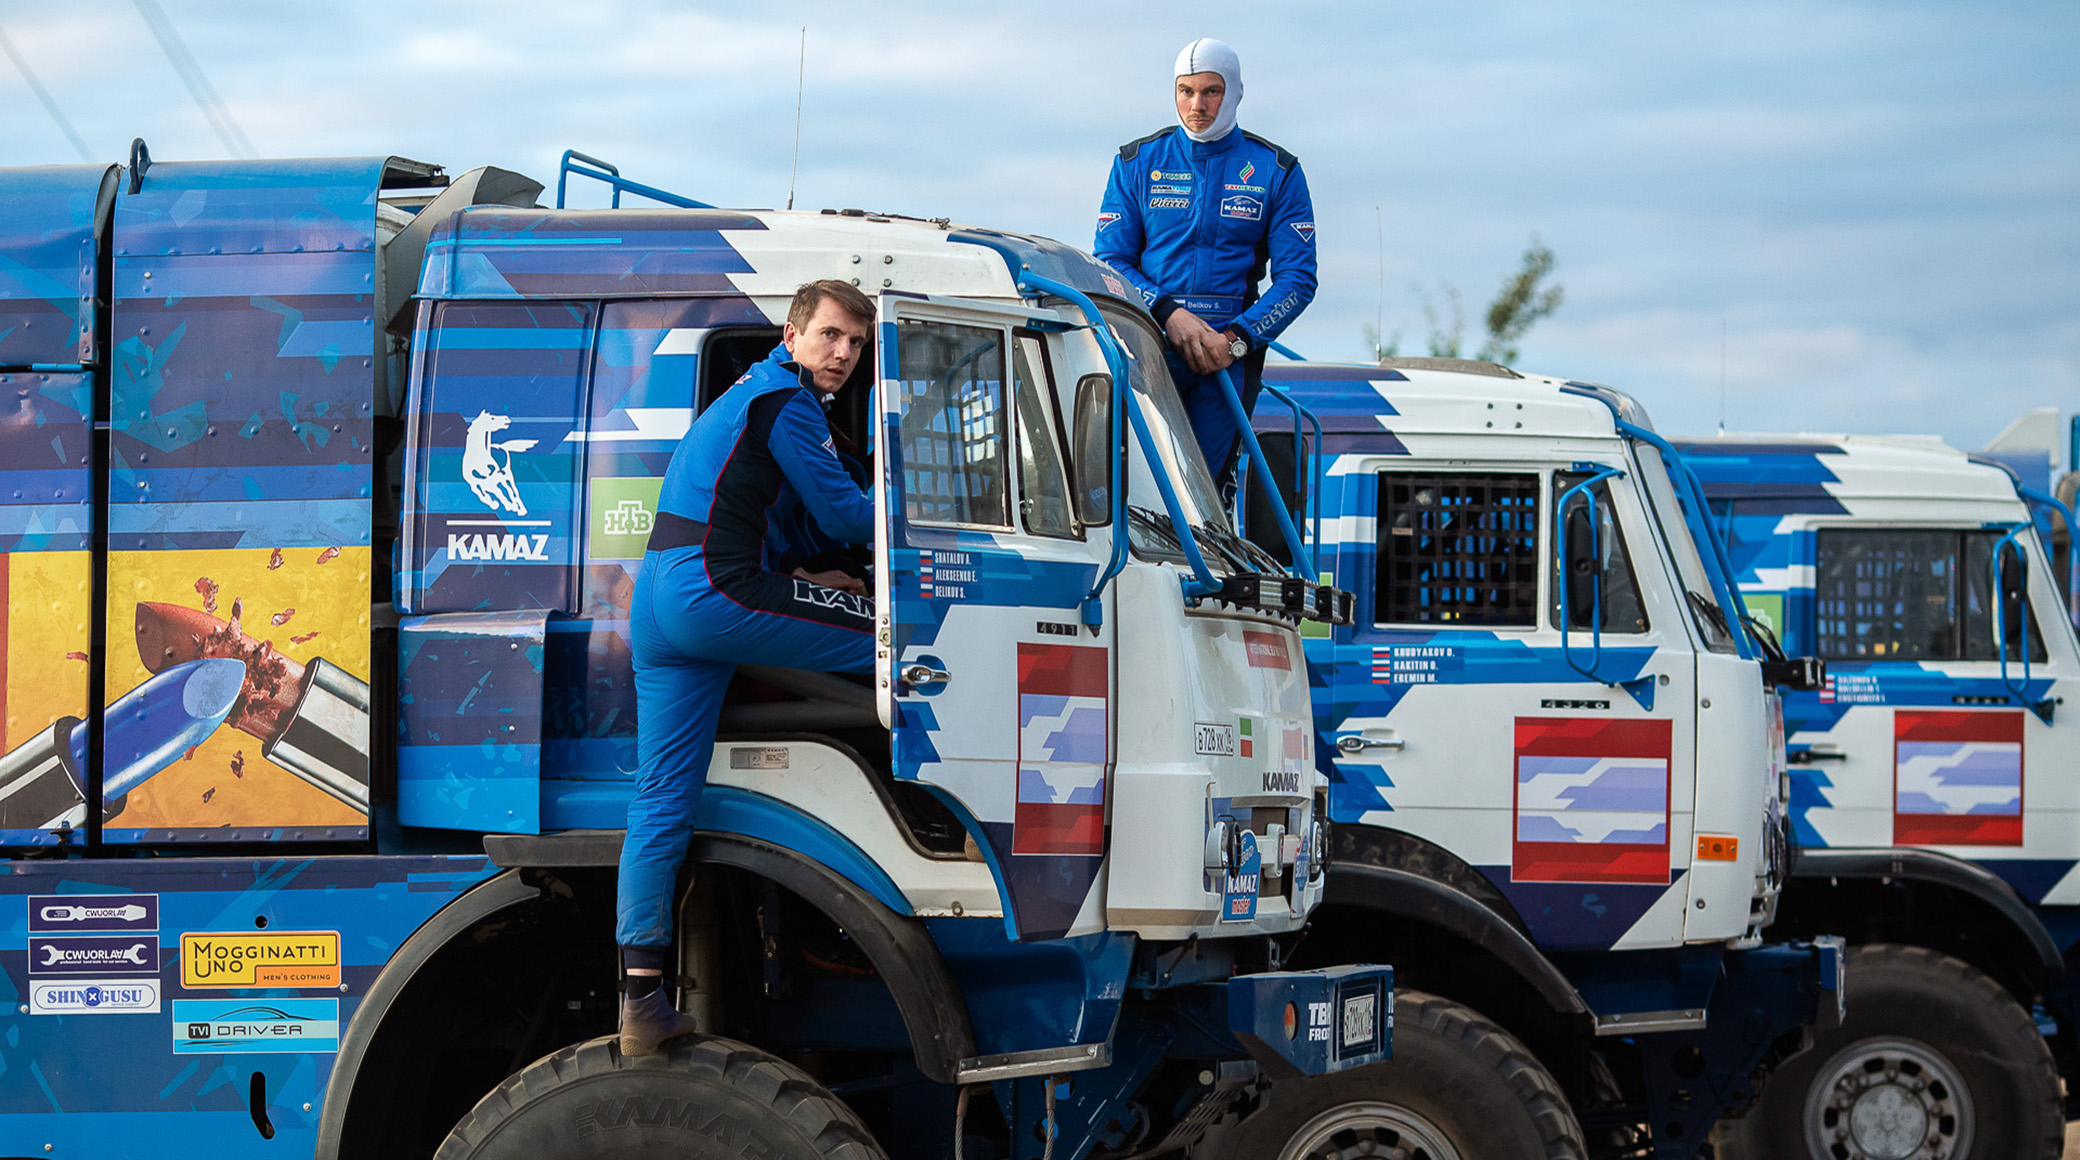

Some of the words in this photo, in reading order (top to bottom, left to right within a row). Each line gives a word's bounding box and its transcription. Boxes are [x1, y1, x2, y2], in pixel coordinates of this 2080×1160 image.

[1224, 204, 1257, 214] KAMAZ
[1187, 301, 1213, 309] Belikov
[1214, 301, 1221, 309] S.
[447, 534, 549, 561] KAMAZ
[935, 569, 971, 582] ALEKSEENKO
[972, 570, 978, 582] E.
[935, 585, 959, 598] BELIKOV
[959, 586, 966, 599] S.
[1040, 622, 1075, 636] 4911
[1394, 660, 1429, 671] RAKITIN
[1393, 673, 1426, 683] EREMIN
[1427, 673, 1438, 683] M.
[1262, 772, 1299, 792] KAMAZ
[1227, 873, 1257, 893] KAMAZ
[193, 941, 325, 959] MOGGINATTI
[195, 960, 243, 978] UNO
[263, 972, 288, 981] MEN'S
[290, 973, 331, 981] CLOTHING
[217, 1025, 302, 1036] DRIVER
[574, 1096, 737, 1148] KAMA
